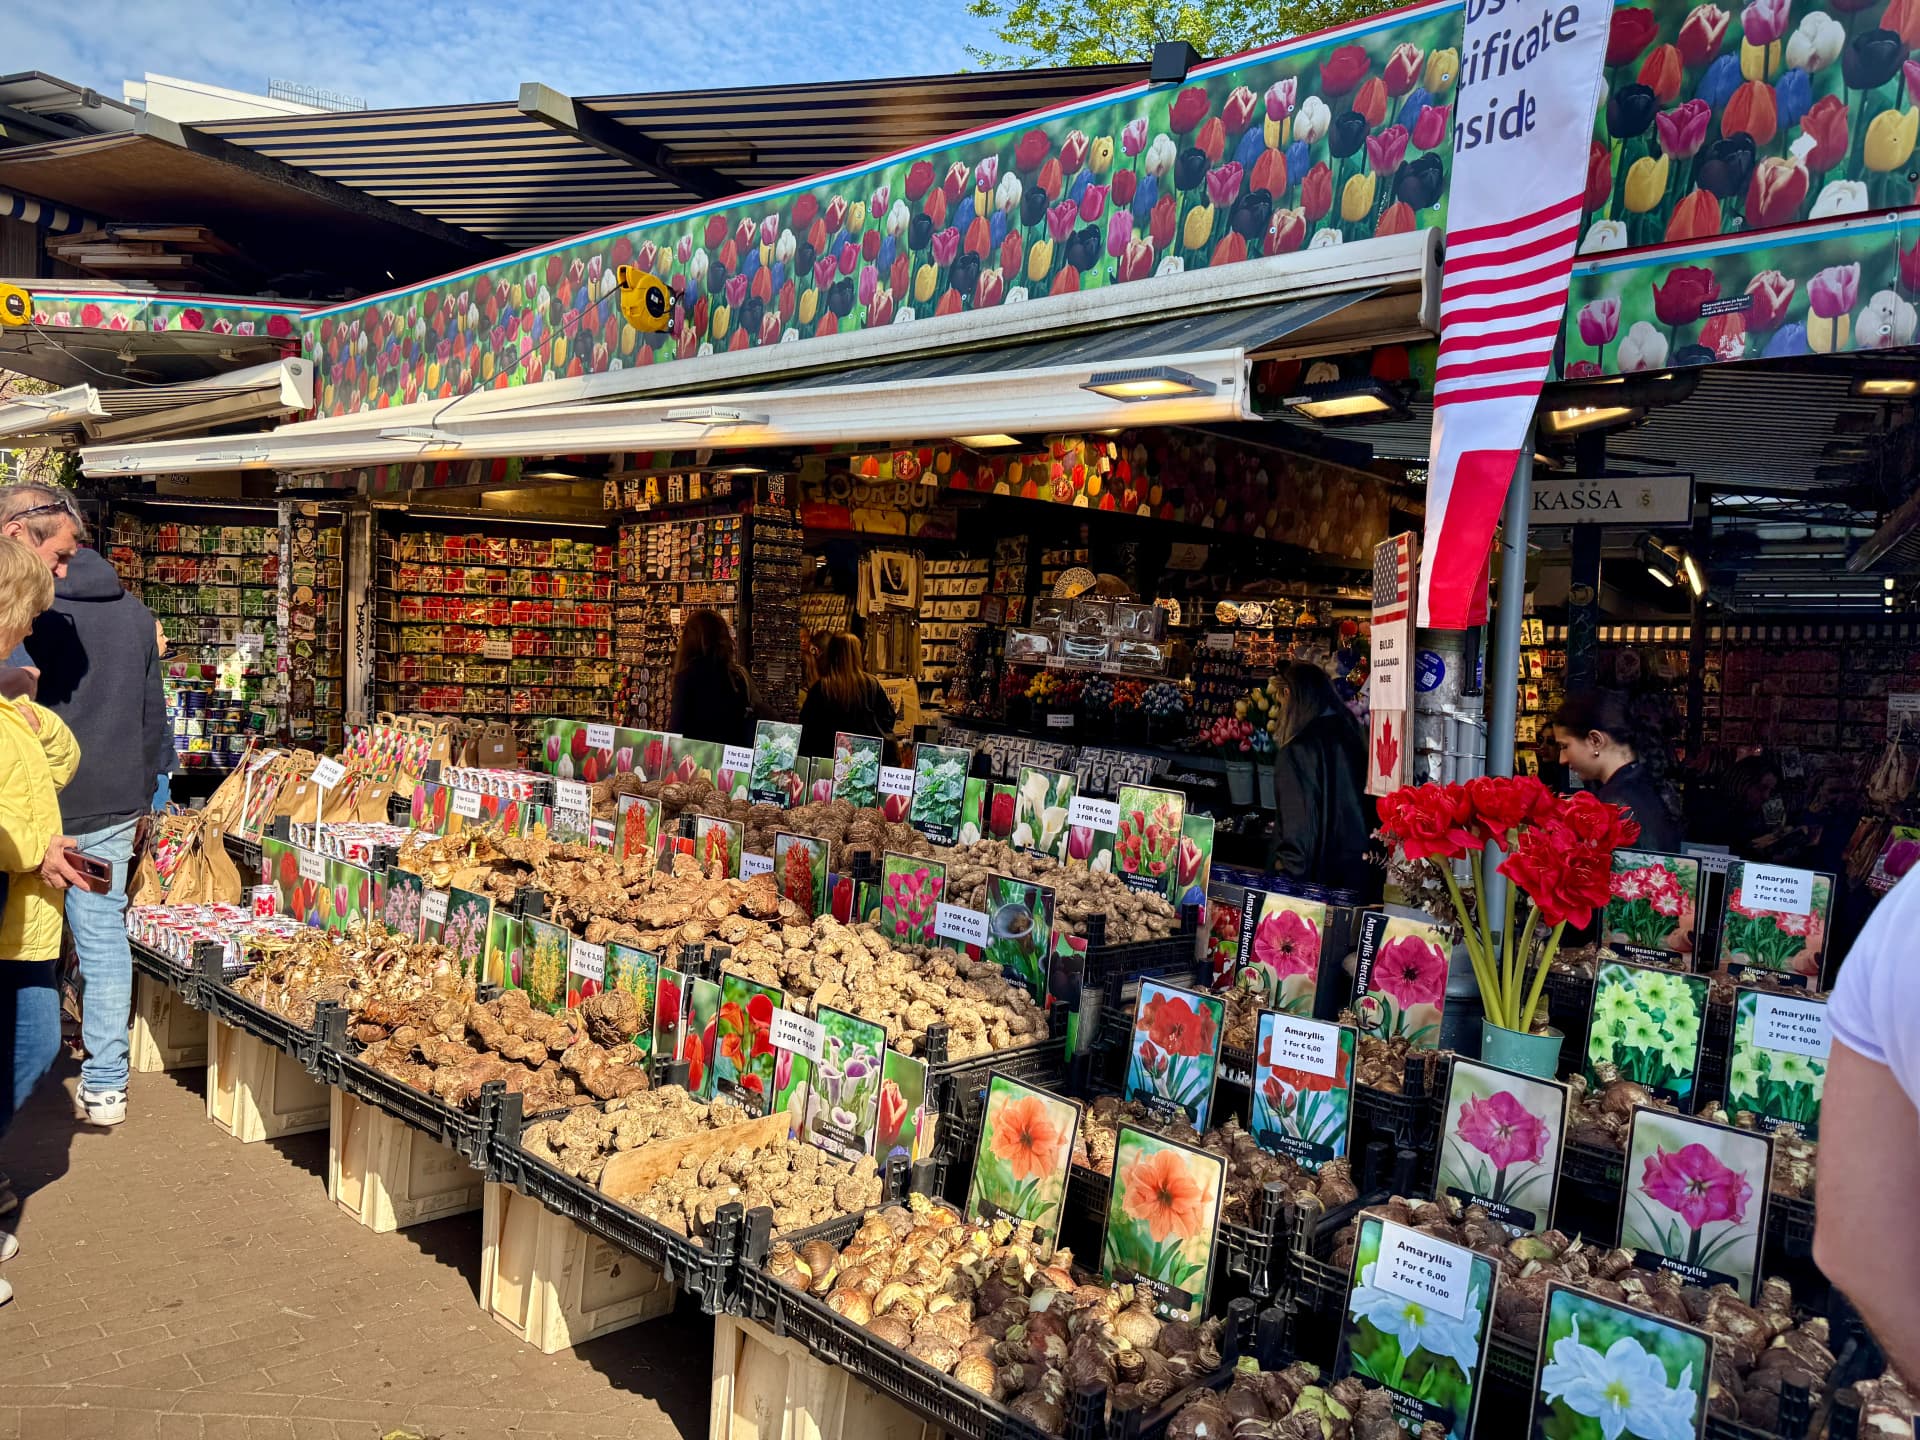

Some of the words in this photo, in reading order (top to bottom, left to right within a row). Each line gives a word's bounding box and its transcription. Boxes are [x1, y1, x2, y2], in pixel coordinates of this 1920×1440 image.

[1534, 489, 1623, 511] KASSA
[1082, 804, 1094, 812] FOR
[1081, 814, 1093, 822] FOR
[1755, 872, 1799, 885] Amaryllis
[1760, 884, 1772, 892] For
[949, 912, 962, 921] FOR
[1243, 892, 1257, 931] Amaryllis
[947, 923, 960, 932] FOR
[1362, 917, 1378, 958] Amaryllis
[1239, 931, 1252, 966] Hercules
[1624, 945, 1668, 957] Hippeastrum
[1357, 957, 1372, 995] Hercules
[1770, 1007, 1822, 1023] Amaryllis
[784, 1021, 798, 1030] FOR
[782, 1032, 796, 1043] FOR
[1284, 1026, 1325, 1042] Amaryllis
[1775, 1032, 1789, 1040] For
[1289, 1040, 1300, 1048] For
[1288, 1050, 1299, 1059] For
[1300, 1052, 1305, 1060] €
[1280, 1136, 1313, 1150] Amaryllis
[1470, 1196, 1510, 1214] Amaryllis
[1397, 1241, 1453, 1268] Amaryllis
[1395, 1257, 1400, 1265] 1
[1402, 1260, 1417, 1271] For
[1419, 1265, 1425, 1274] €
[1426, 1269, 1447, 1282] 6,00
[1660, 1258, 1708, 1278] Amaryllis
[1134, 1272, 1170, 1294] Amaryllis
[1392, 1271, 1398, 1279] 2
[1400, 1274, 1415, 1285] For
[1416, 1279, 1422, 1289] €
[1425, 1284, 1450, 1299] 10,00
[1410, 1409, 1423, 1420] Gift
